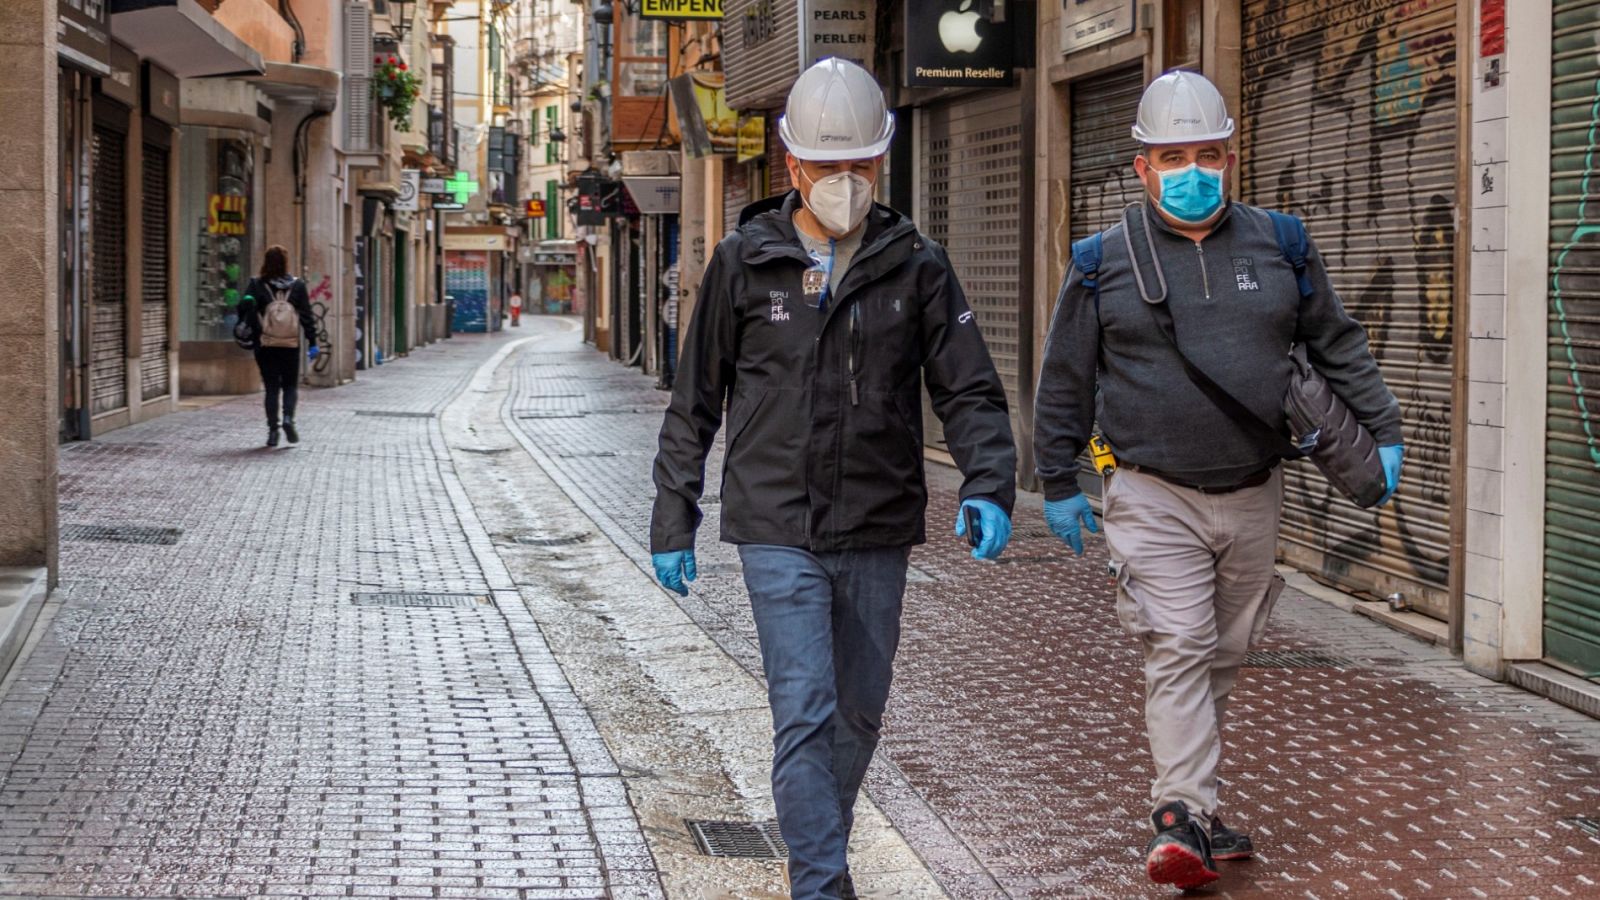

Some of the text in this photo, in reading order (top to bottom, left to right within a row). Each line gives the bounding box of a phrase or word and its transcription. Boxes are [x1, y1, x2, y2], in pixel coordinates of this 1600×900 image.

[814, 10, 866, 20] PEARLS
[814, 33, 866, 43] PERLEN
[915, 67, 1005, 78] Premium Reseller
[1236, 274, 1250, 282] FE
